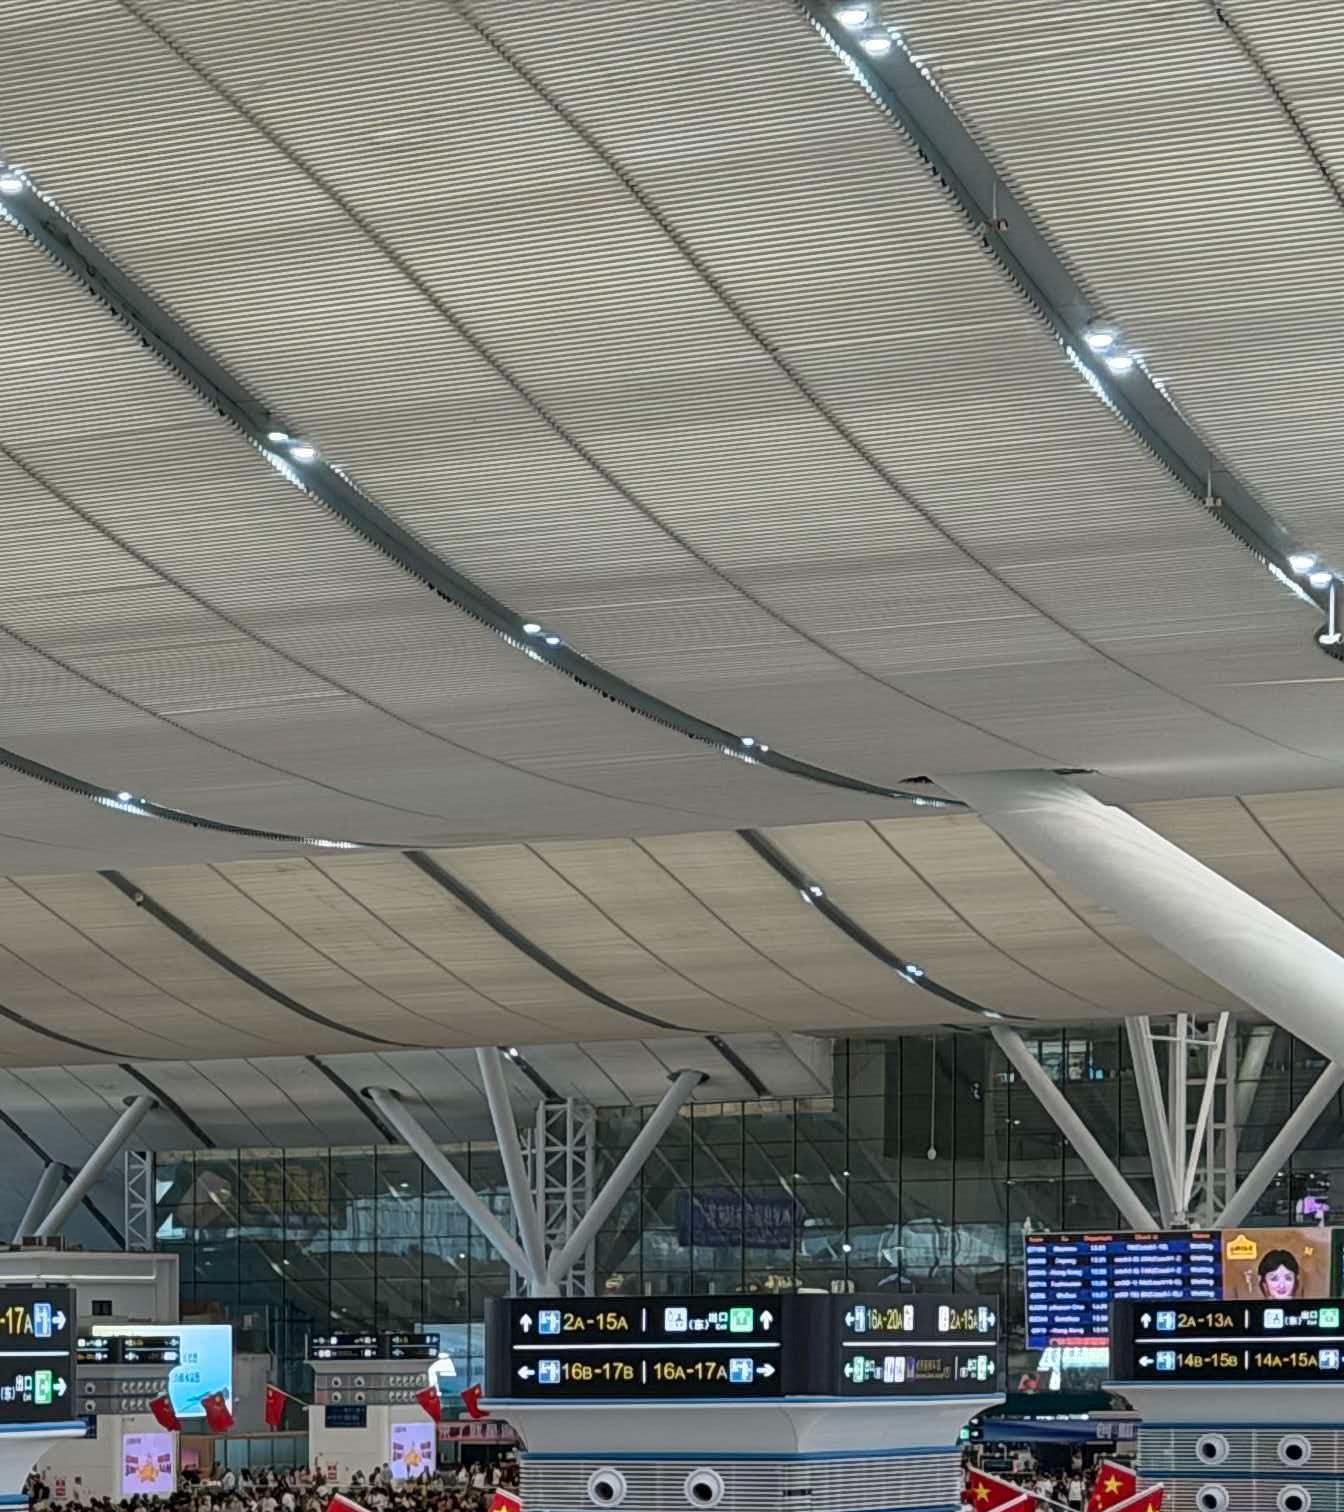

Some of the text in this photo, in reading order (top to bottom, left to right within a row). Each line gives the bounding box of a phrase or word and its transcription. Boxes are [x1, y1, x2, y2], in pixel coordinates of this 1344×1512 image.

[562, 1312, 629, 1331] 2A-15A
[1177, 1313, 1233, 1328] 2A-13A
[1176, 1353, 1318, 1368] 14B-15B 14A-15A
[561, 1362, 728, 1380] 16B-17B 16A-17A
